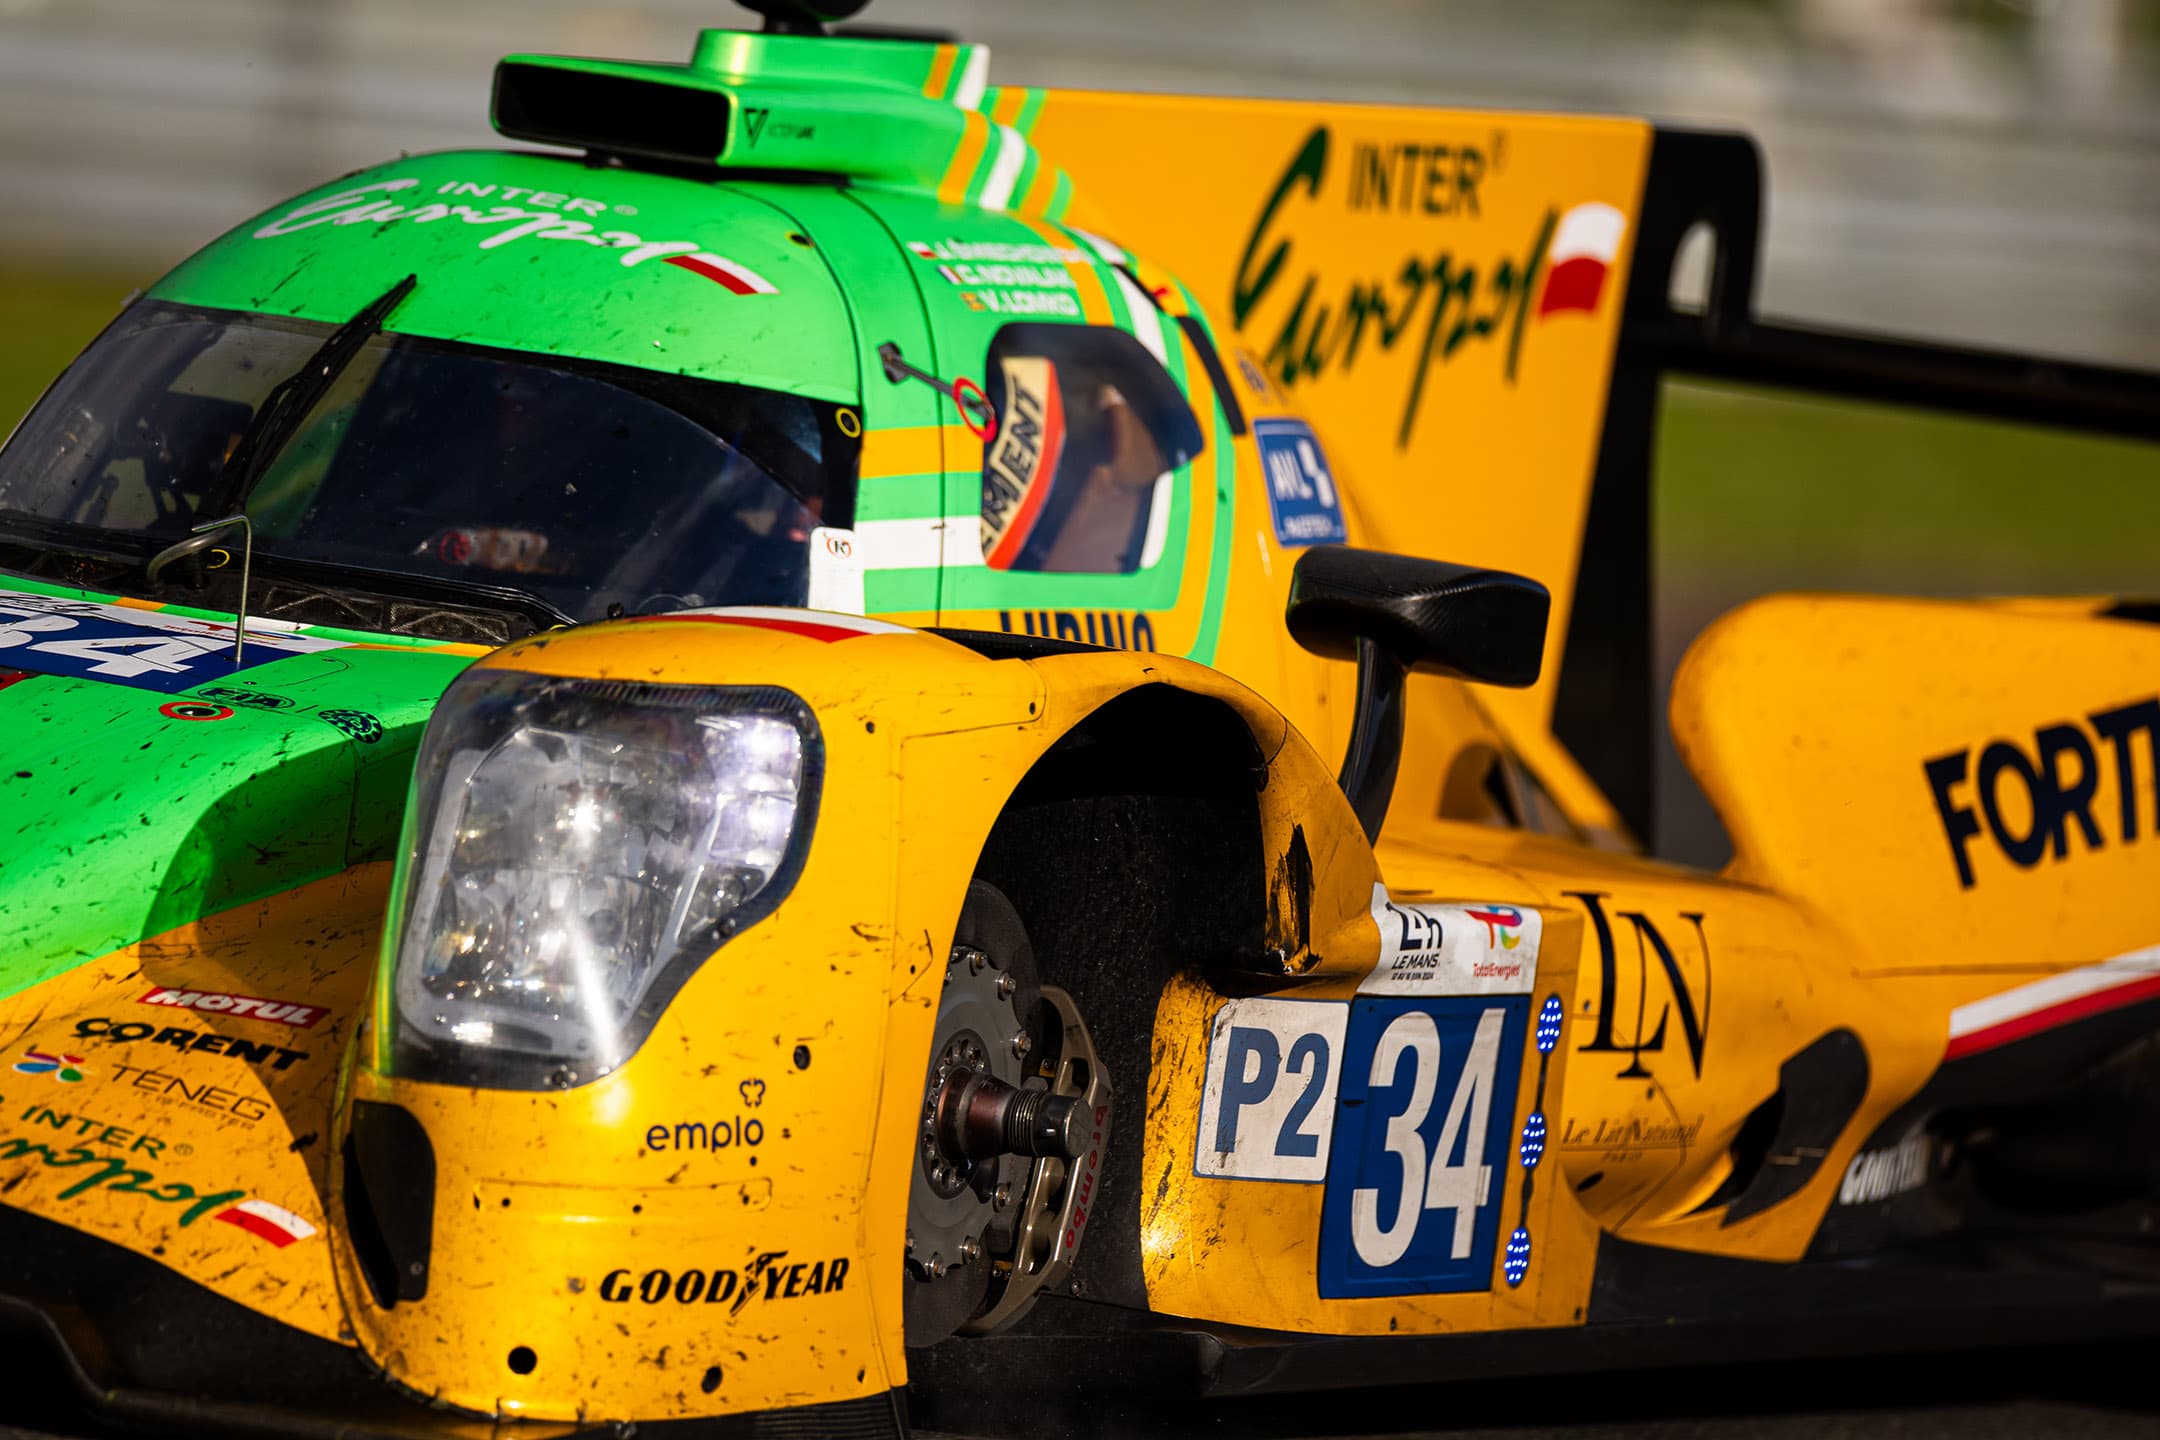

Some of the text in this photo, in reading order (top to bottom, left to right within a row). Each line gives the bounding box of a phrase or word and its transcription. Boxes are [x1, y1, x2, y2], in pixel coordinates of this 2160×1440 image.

[145, 989, 315, 1026] MOTUL
[111, 1063, 271, 1122] TENEG
[1214, 1025, 1330, 1159] P2
[20, 1106, 167, 1161] INTER
[646, 1115, 765, 1153] emplo
[1351, 1007, 1507, 1268] 34
[1065, 1105, 1108, 1250] brembo
